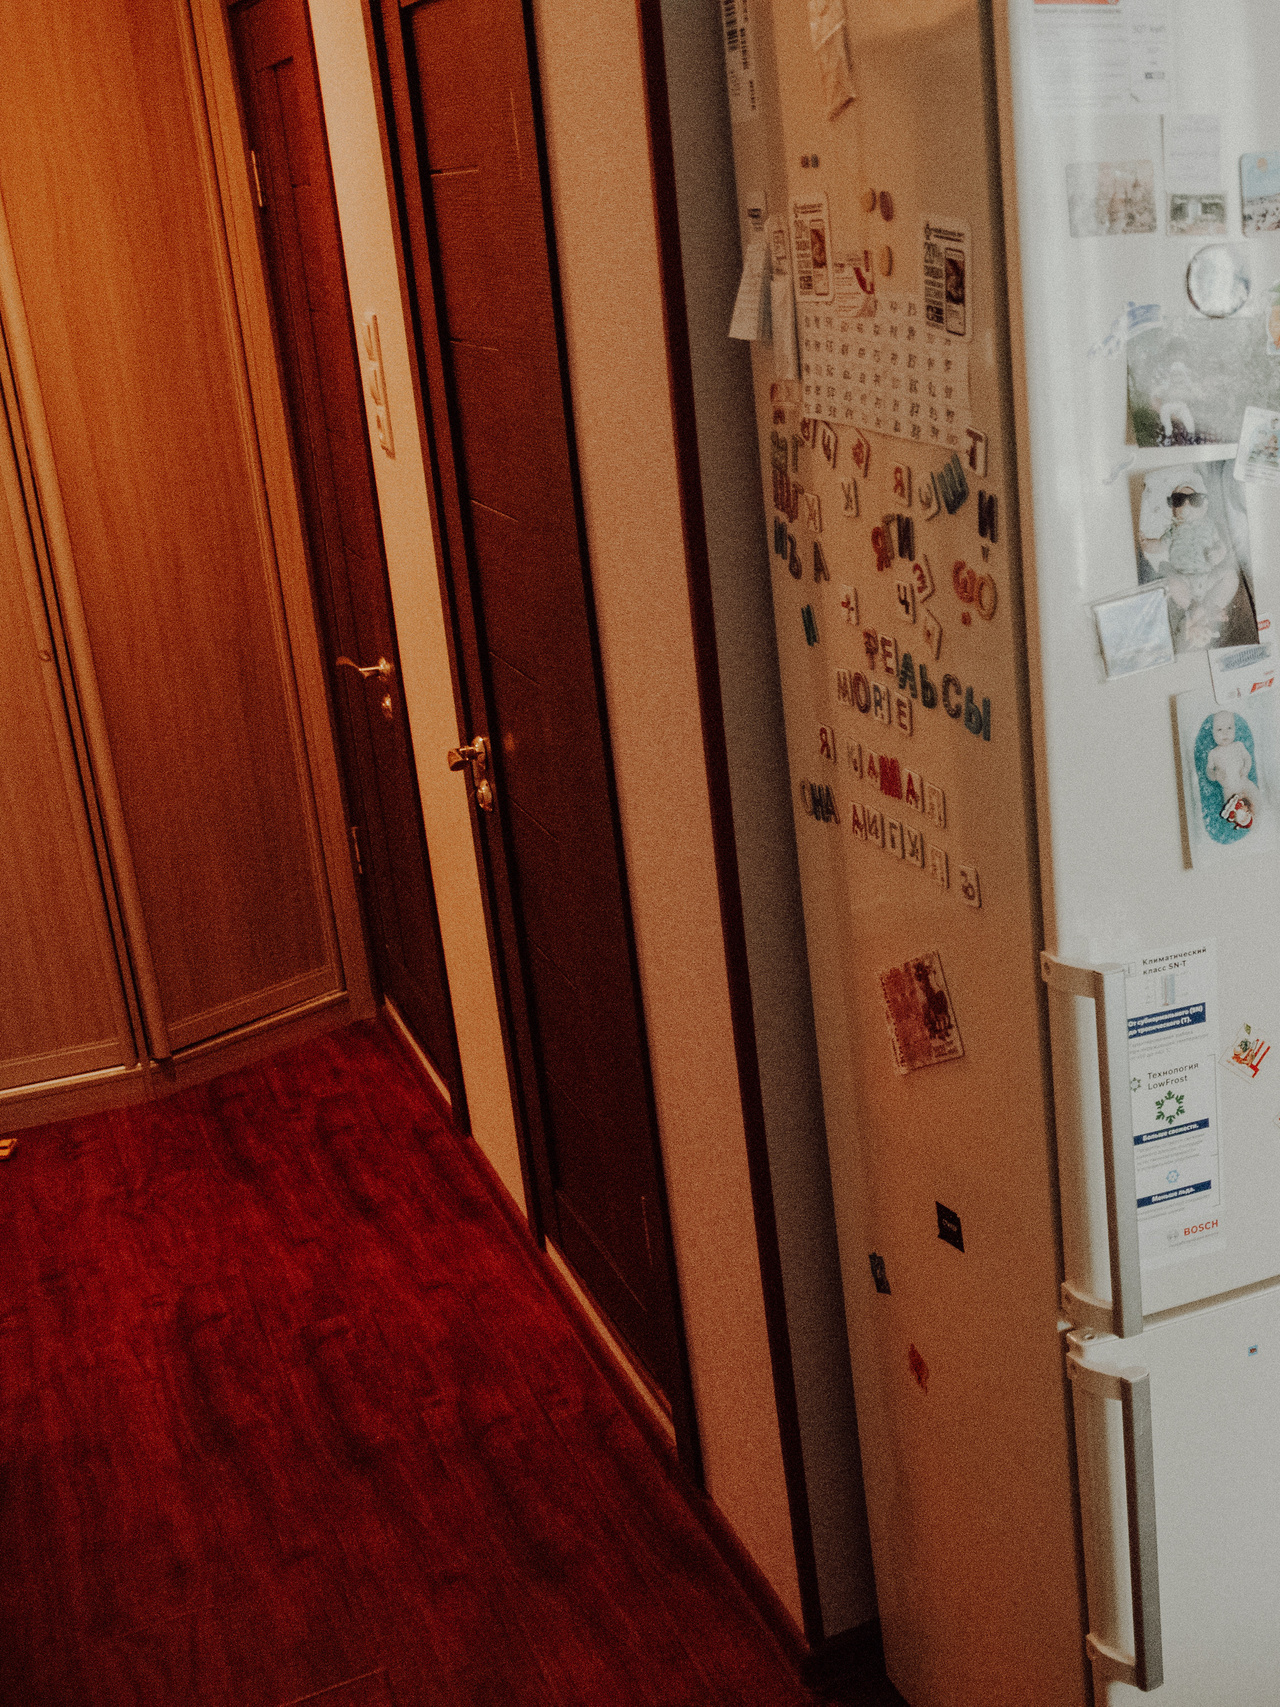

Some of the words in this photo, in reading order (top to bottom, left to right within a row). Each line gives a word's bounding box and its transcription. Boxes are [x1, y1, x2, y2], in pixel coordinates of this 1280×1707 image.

[1142, 946, 1207, 966] Климатический
[1142, 965, 1167, 976] класс
[1168, 960, 1187, 970] SN-T
[1147, 1062, 1199, 1080] Технология
[1147, 1075, 1188, 1091] LowFrost
[1183, 1219, 1219, 1237] BOSCH
